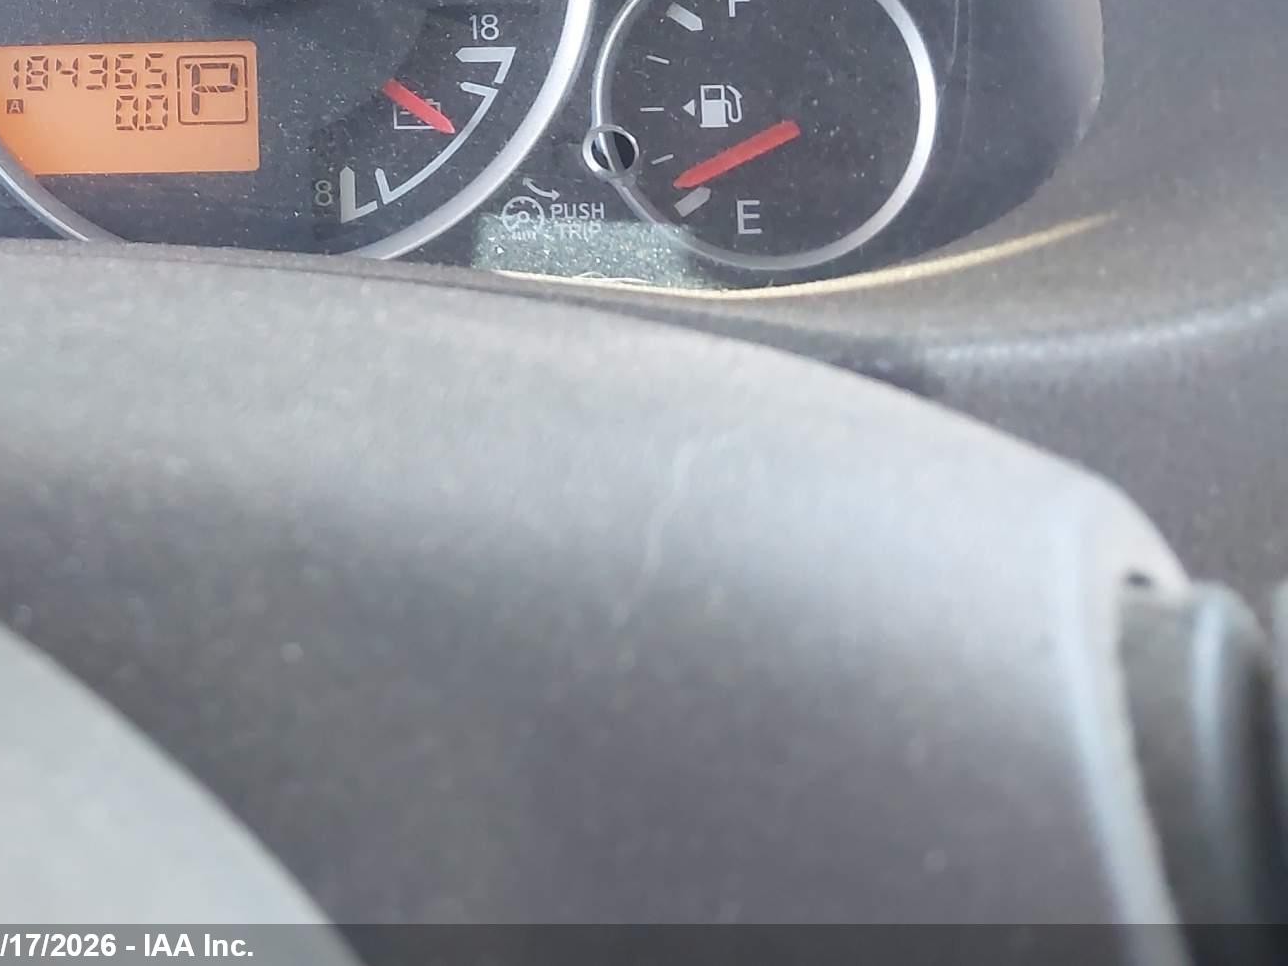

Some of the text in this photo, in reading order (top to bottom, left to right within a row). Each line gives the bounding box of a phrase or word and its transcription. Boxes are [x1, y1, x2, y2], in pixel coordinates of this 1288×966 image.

[469, 14, 500, 40] 18
[13, 53, 167, 91] 184365
[186, 63, 238, 115] P
[115, 95, 168, 130] 0.0
[315, 180, 333, 206] 8
[550, 202, 605, 219] PUSH
[737, 200, 762, 234] E
